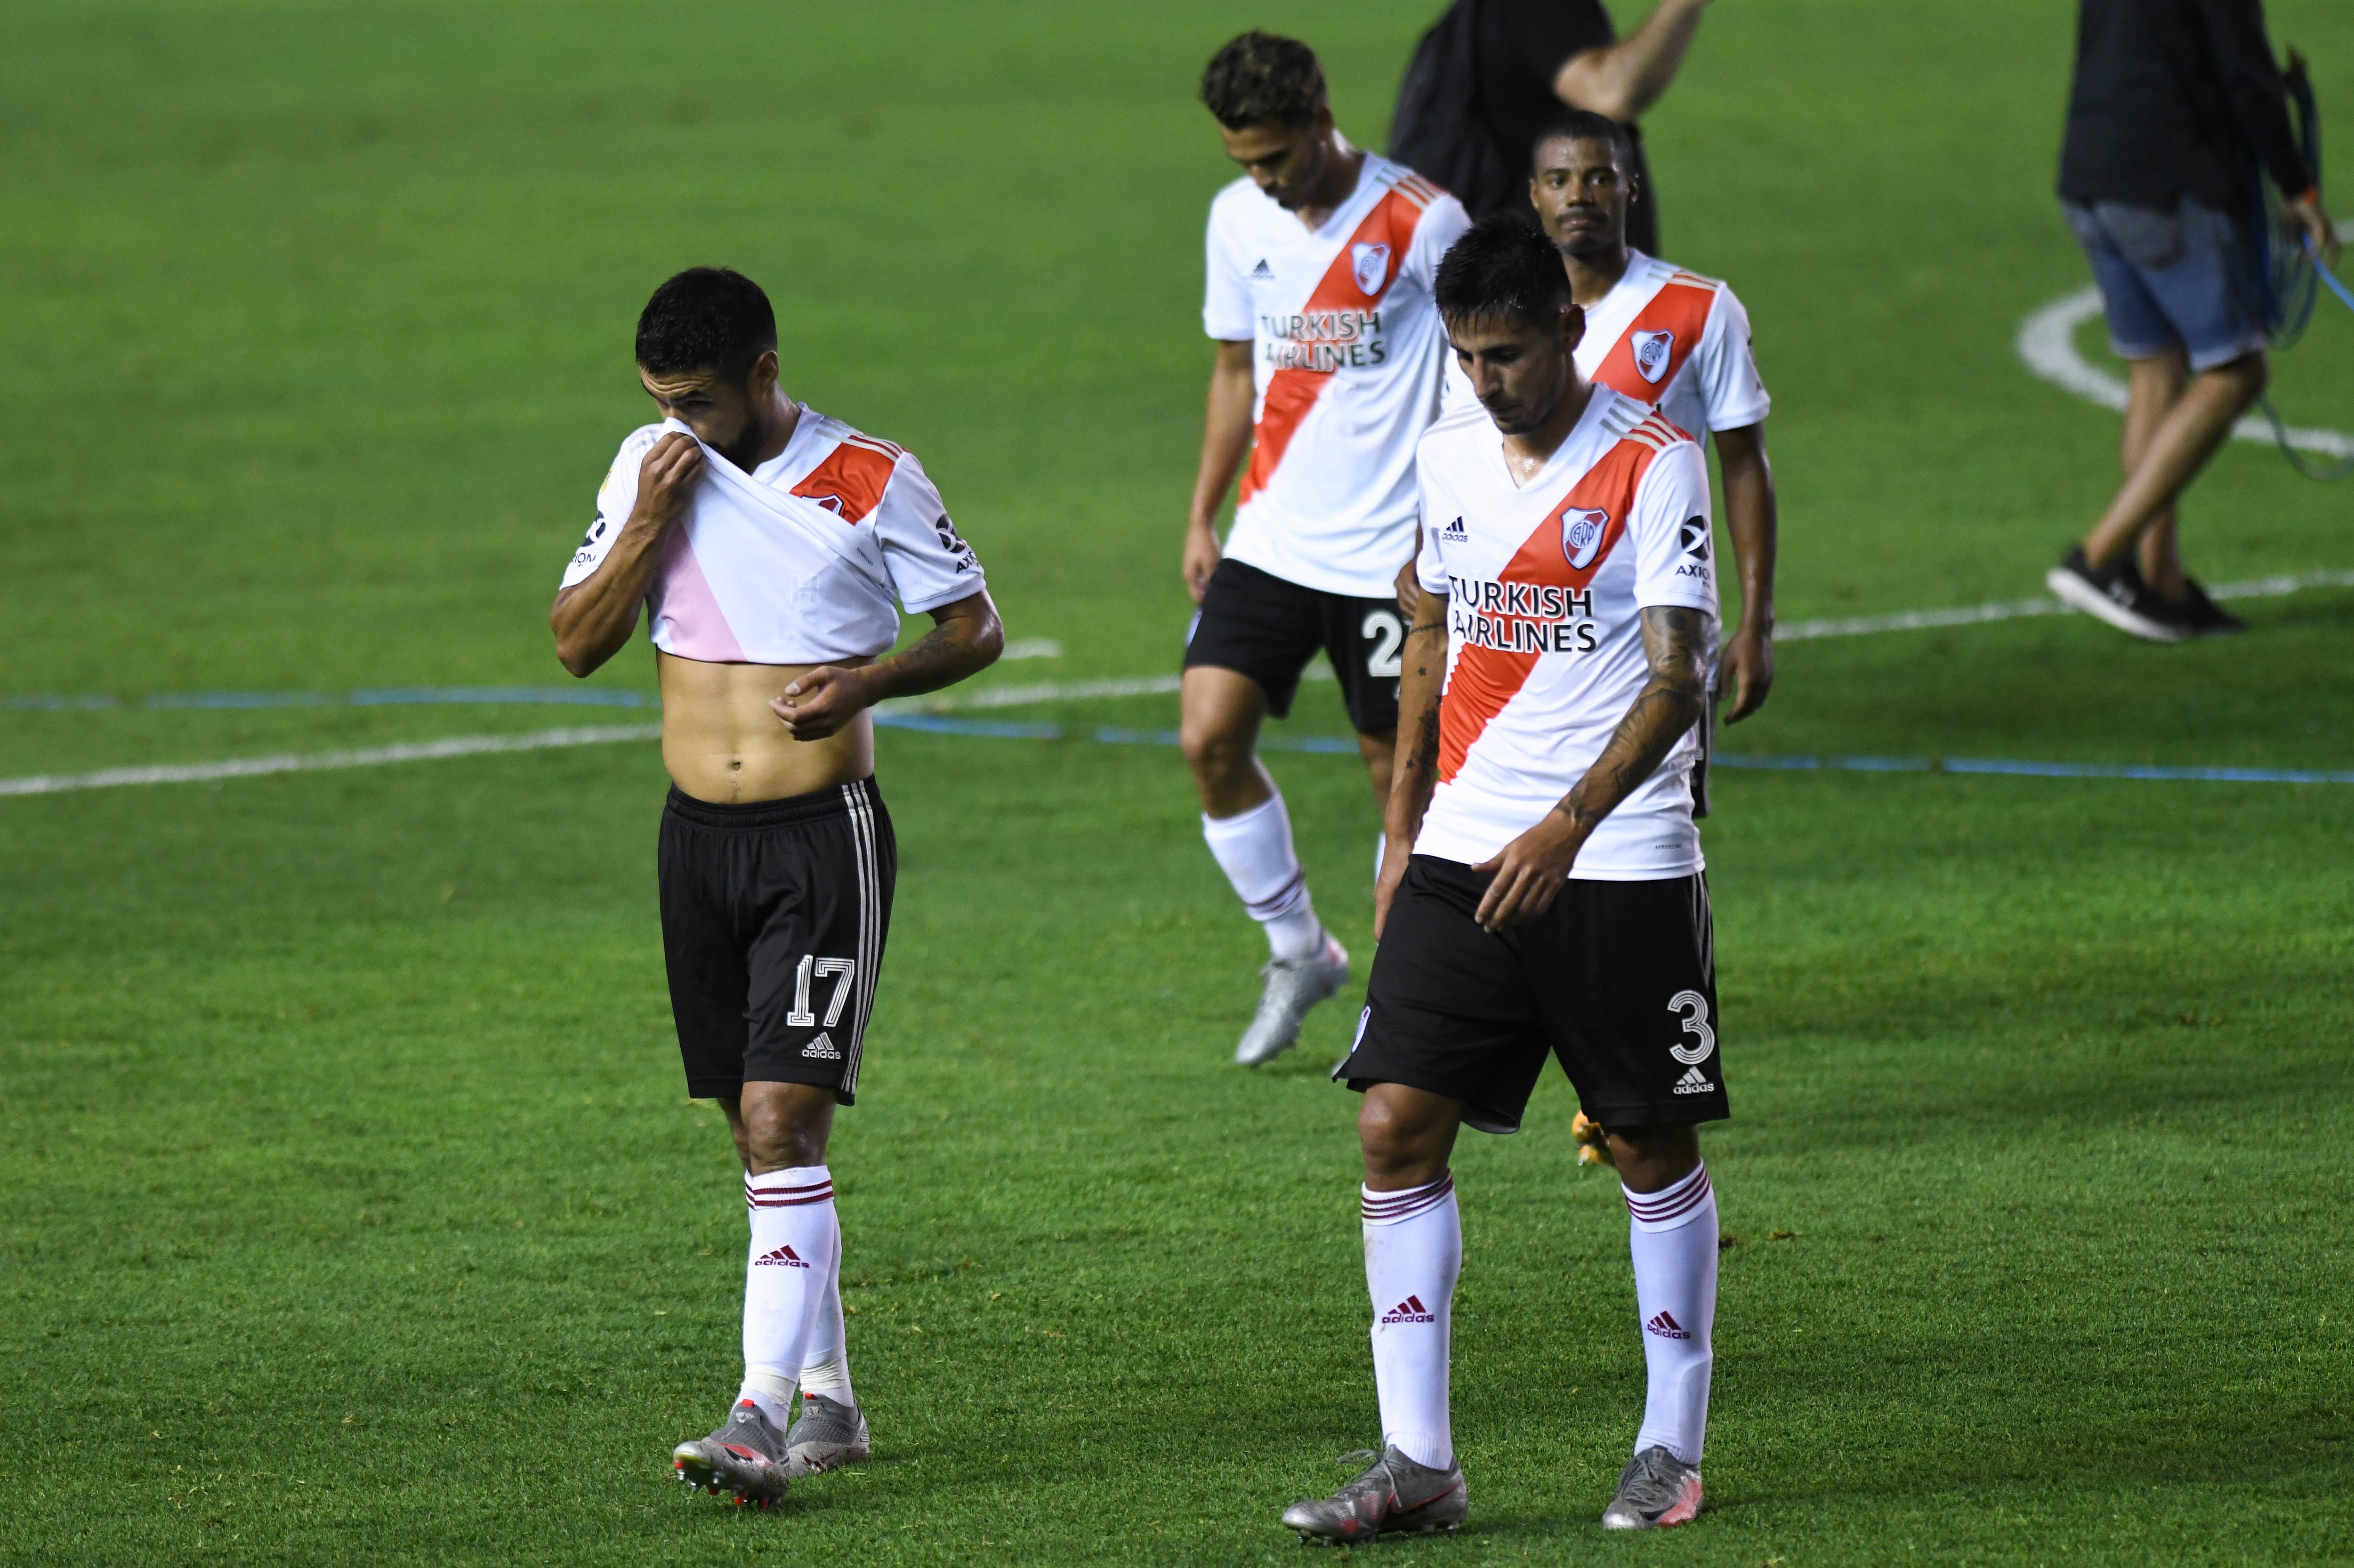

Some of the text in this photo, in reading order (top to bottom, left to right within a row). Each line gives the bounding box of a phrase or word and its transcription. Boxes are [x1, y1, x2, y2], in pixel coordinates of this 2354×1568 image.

[1261, 311, 1381, 340] TURKISH
[1266, 341, 1385, 371] AIRLINES
[1442, 533, 1468, 542] adidas
[1675, 564, 1710, 580] AXIO
[1448, 574, 1593, 619] TURKISH
[1453, 610, 1597, 653] AIRLINES
[787, 954, 855, 1027] 17
[1667, 989, 1715, 1065] 3
[802, 1049, 842, 1060] adidas
[1673, 1083, 1715, 1095] adidas
[755, 1258, 810, 1269] adidas
[1382, 1312, 1435, 1324] adidas
[1647, 1323, 1691, 1340] adidas
